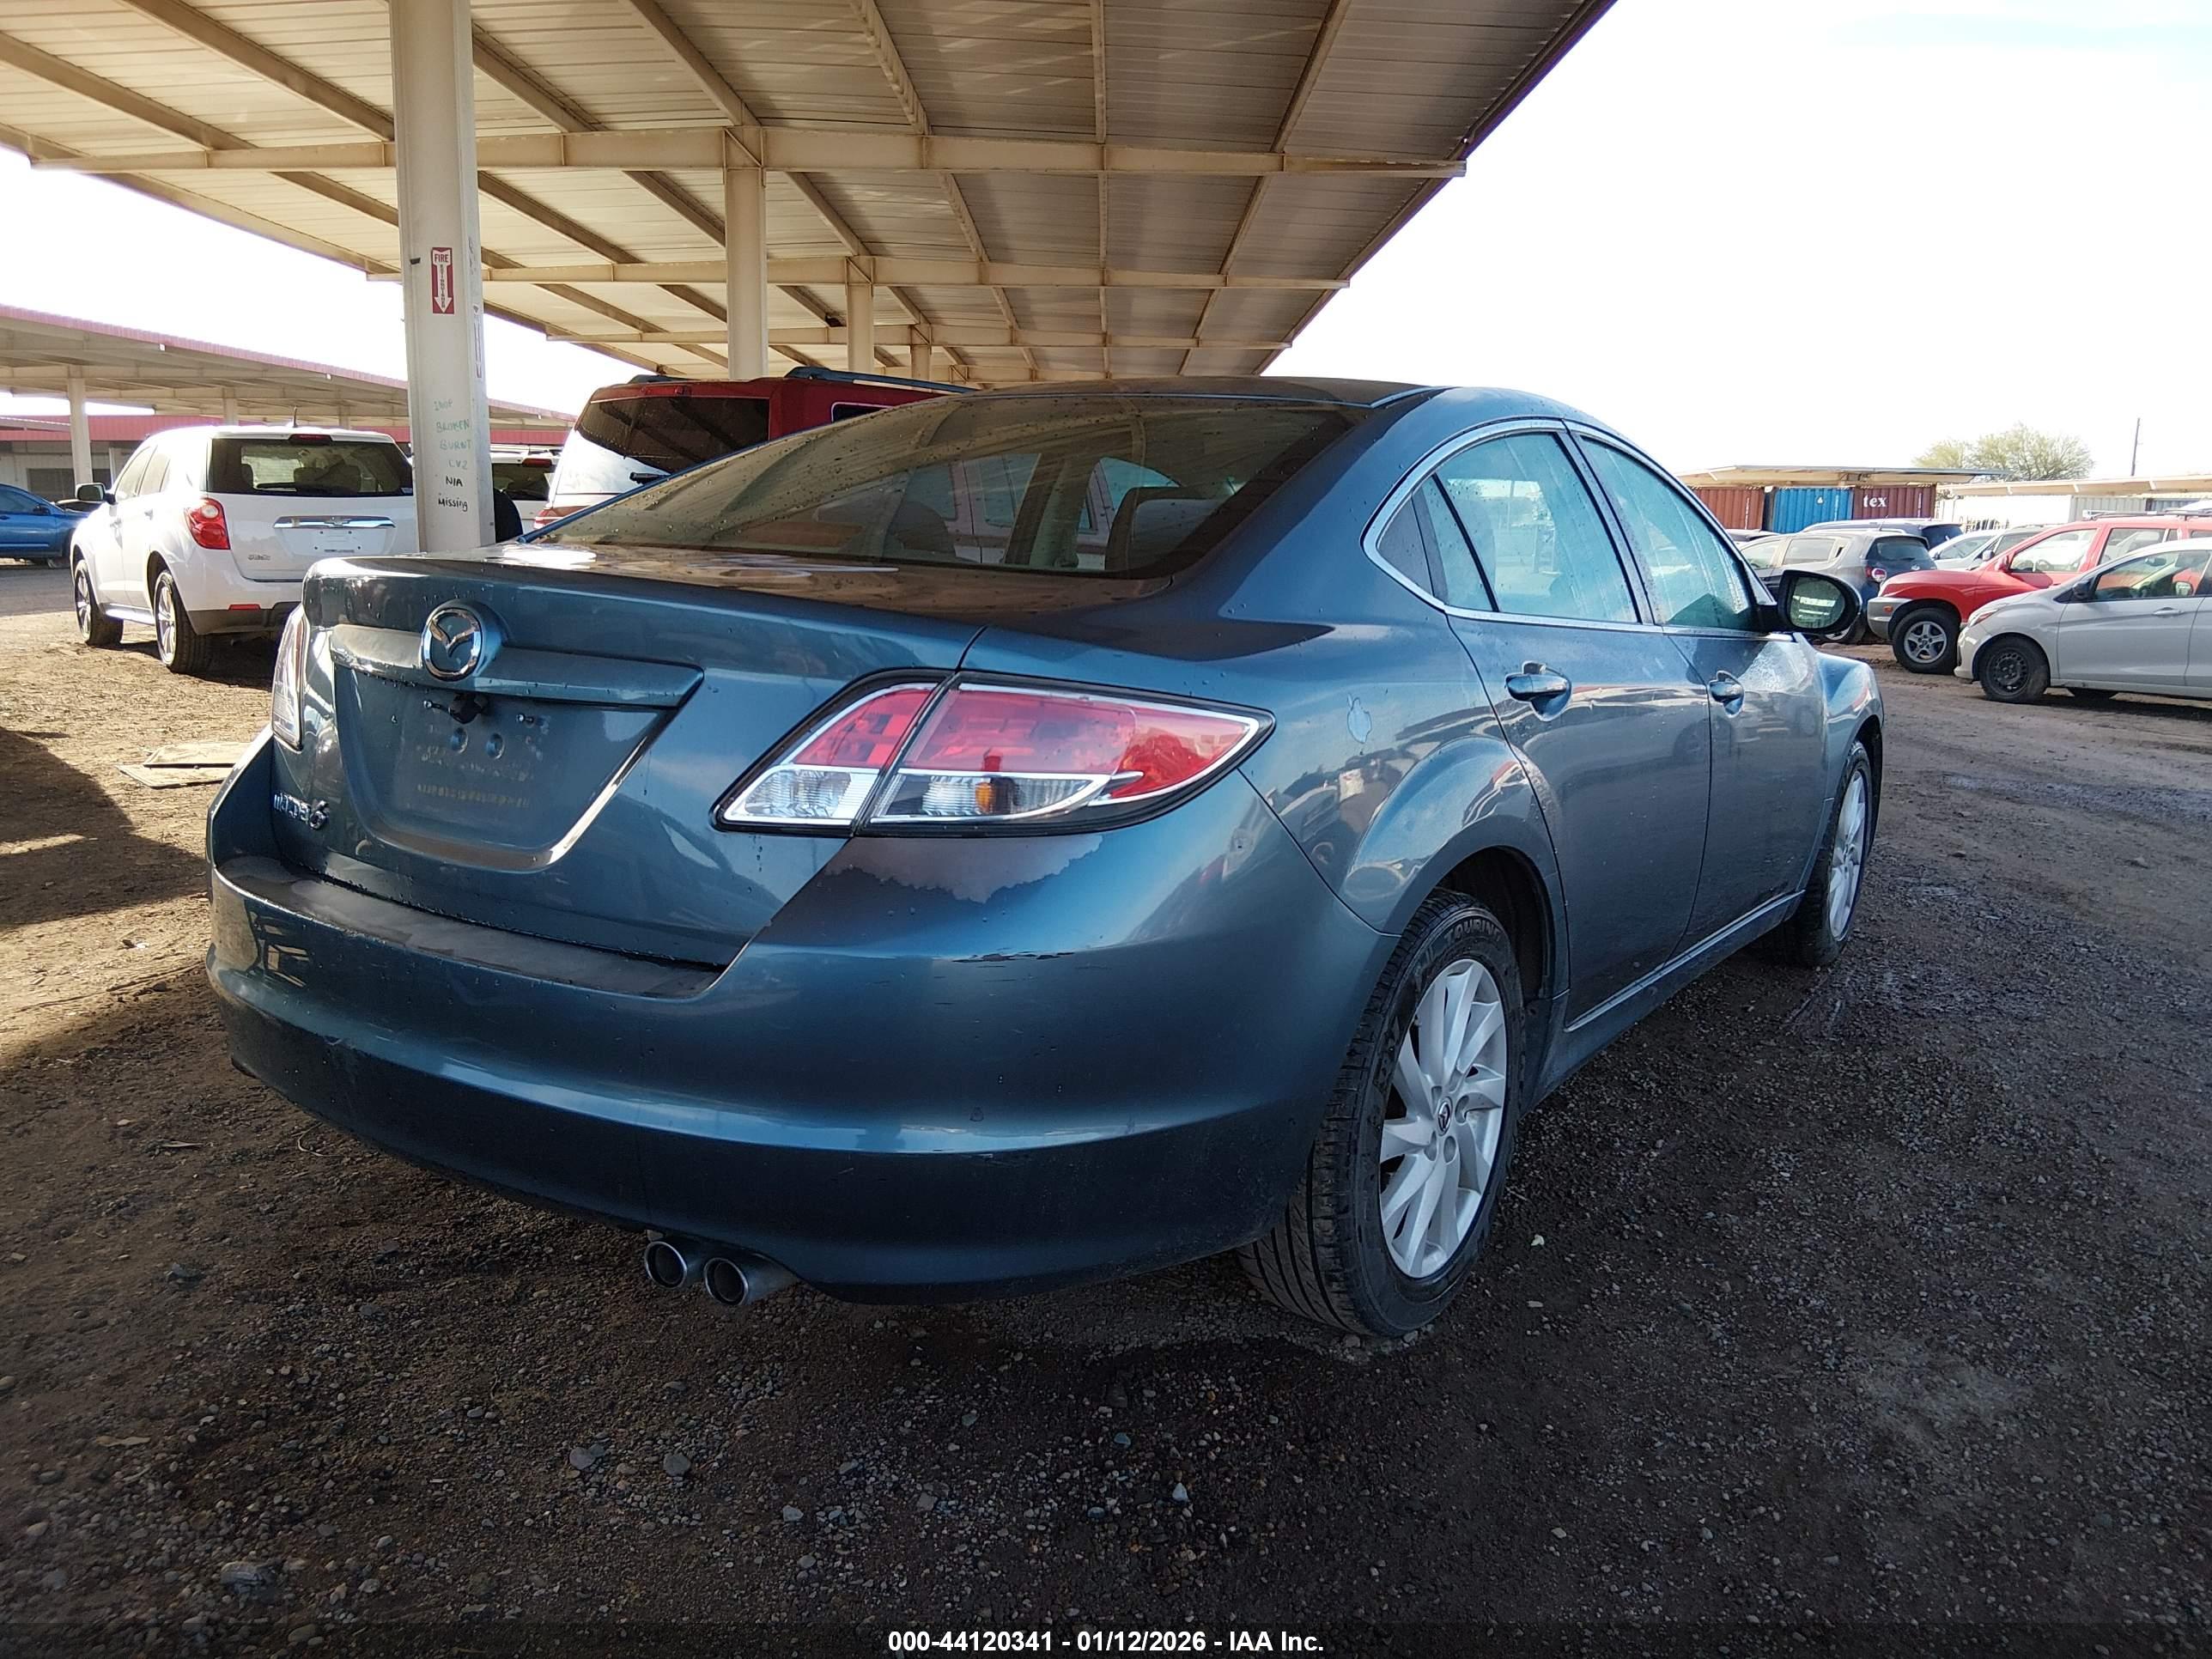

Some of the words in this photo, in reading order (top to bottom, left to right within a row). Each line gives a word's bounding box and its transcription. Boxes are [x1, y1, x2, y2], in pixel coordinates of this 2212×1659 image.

[434, 253, 449, 263] FIRE
[436, 419, 470, 433] BROKEN
[438, 496, 468, 513] Missing
[1863, 494, 1887, 507] tex
